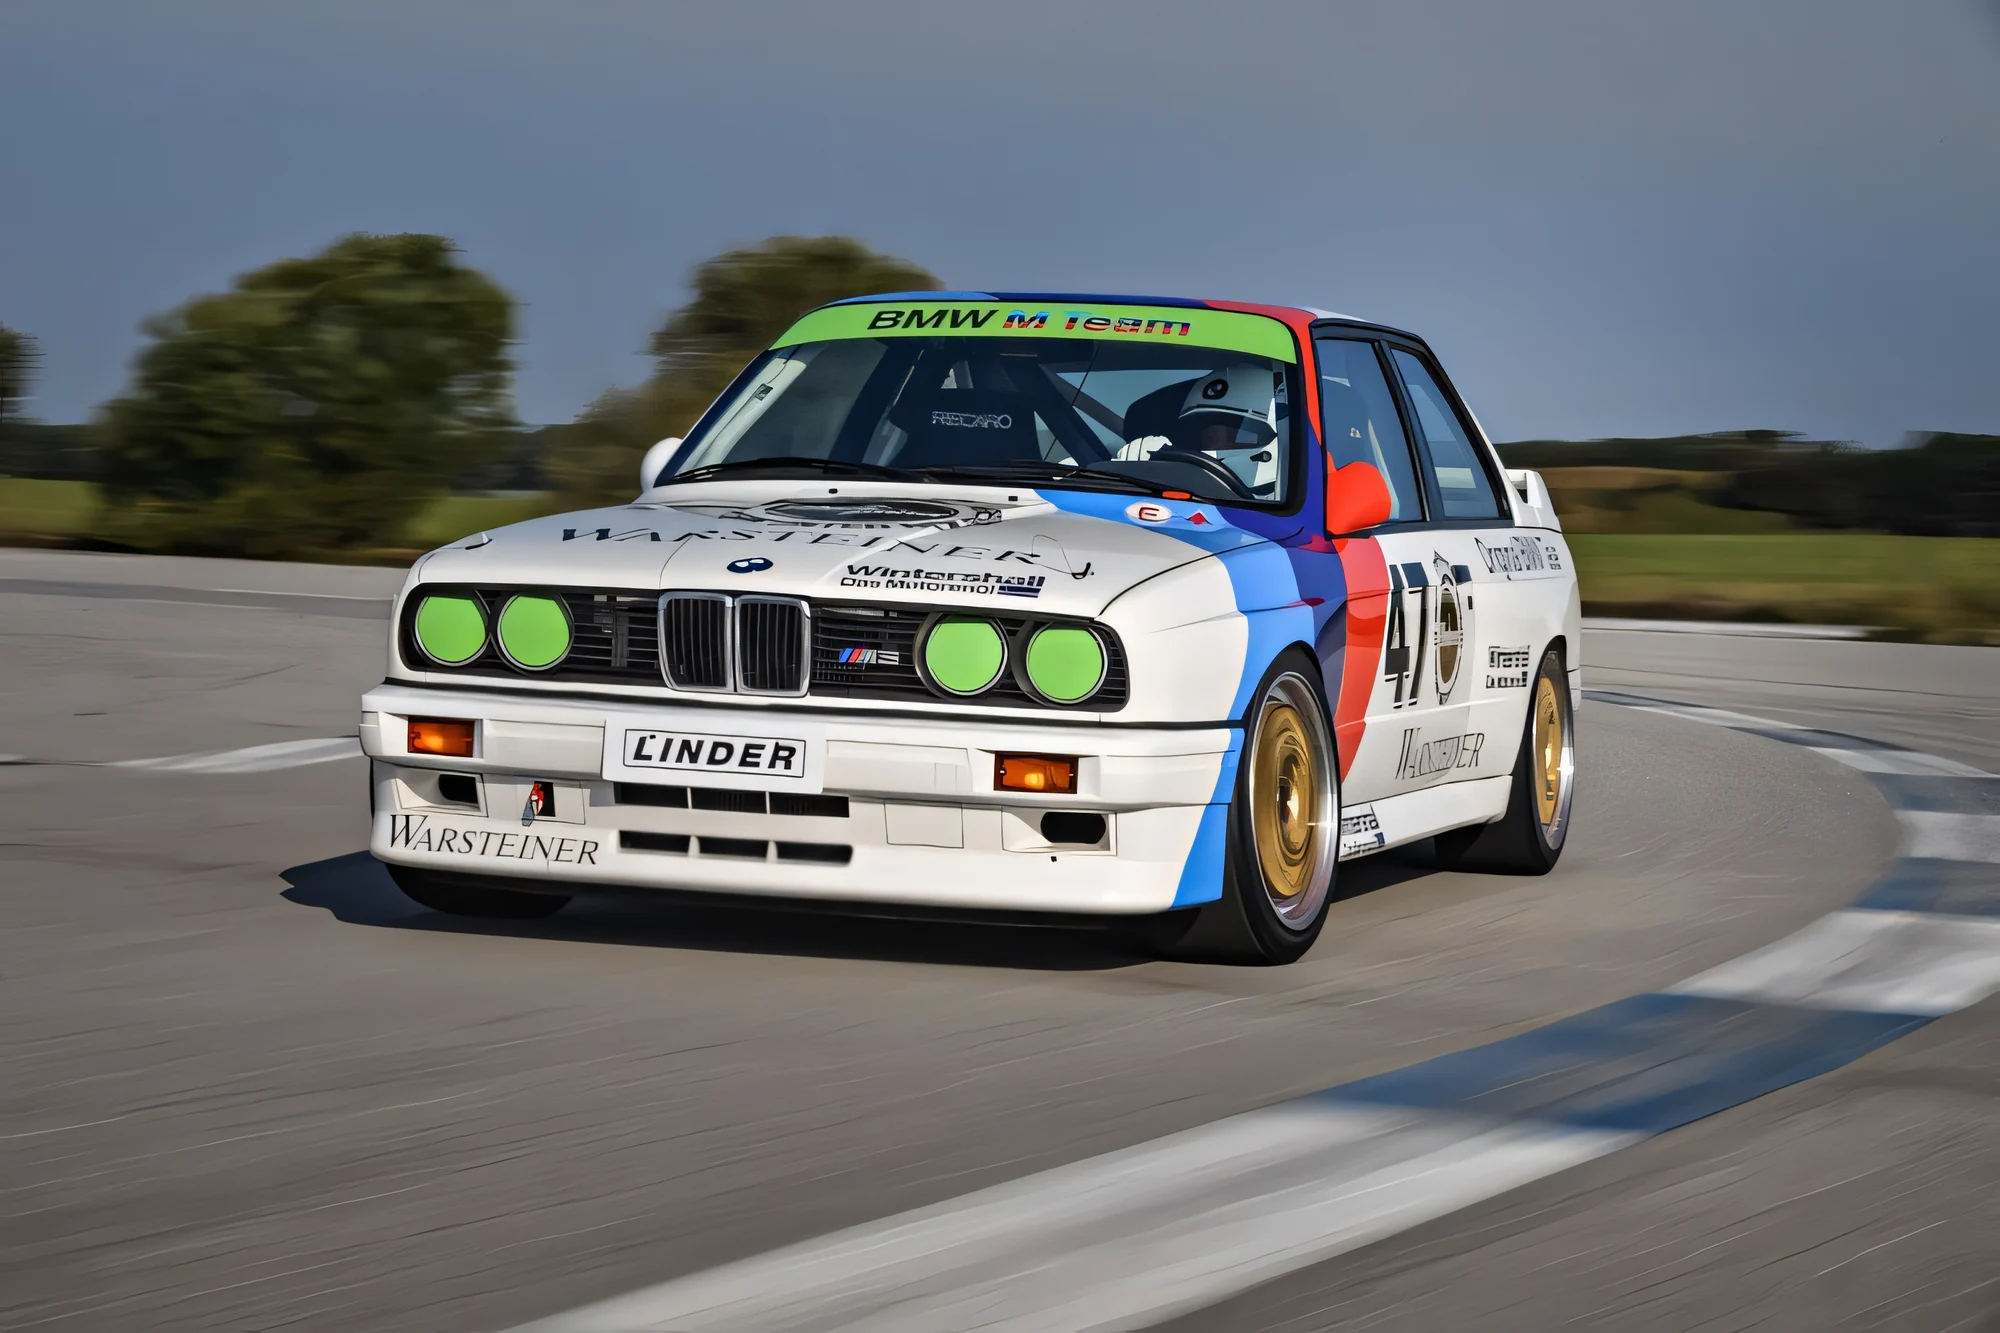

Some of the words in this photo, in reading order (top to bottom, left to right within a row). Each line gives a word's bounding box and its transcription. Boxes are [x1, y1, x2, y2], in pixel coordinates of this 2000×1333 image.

[867, 309, 999, 330] BMW
[1002, 310, 1049, 329] M
[1063, 310, 1192, 336] Team
[561, 527, 1041, 565] WARSTEINER
[632, 734, 798, 771] LINDER
[389, 814, 599, 865] WARSTEINER
